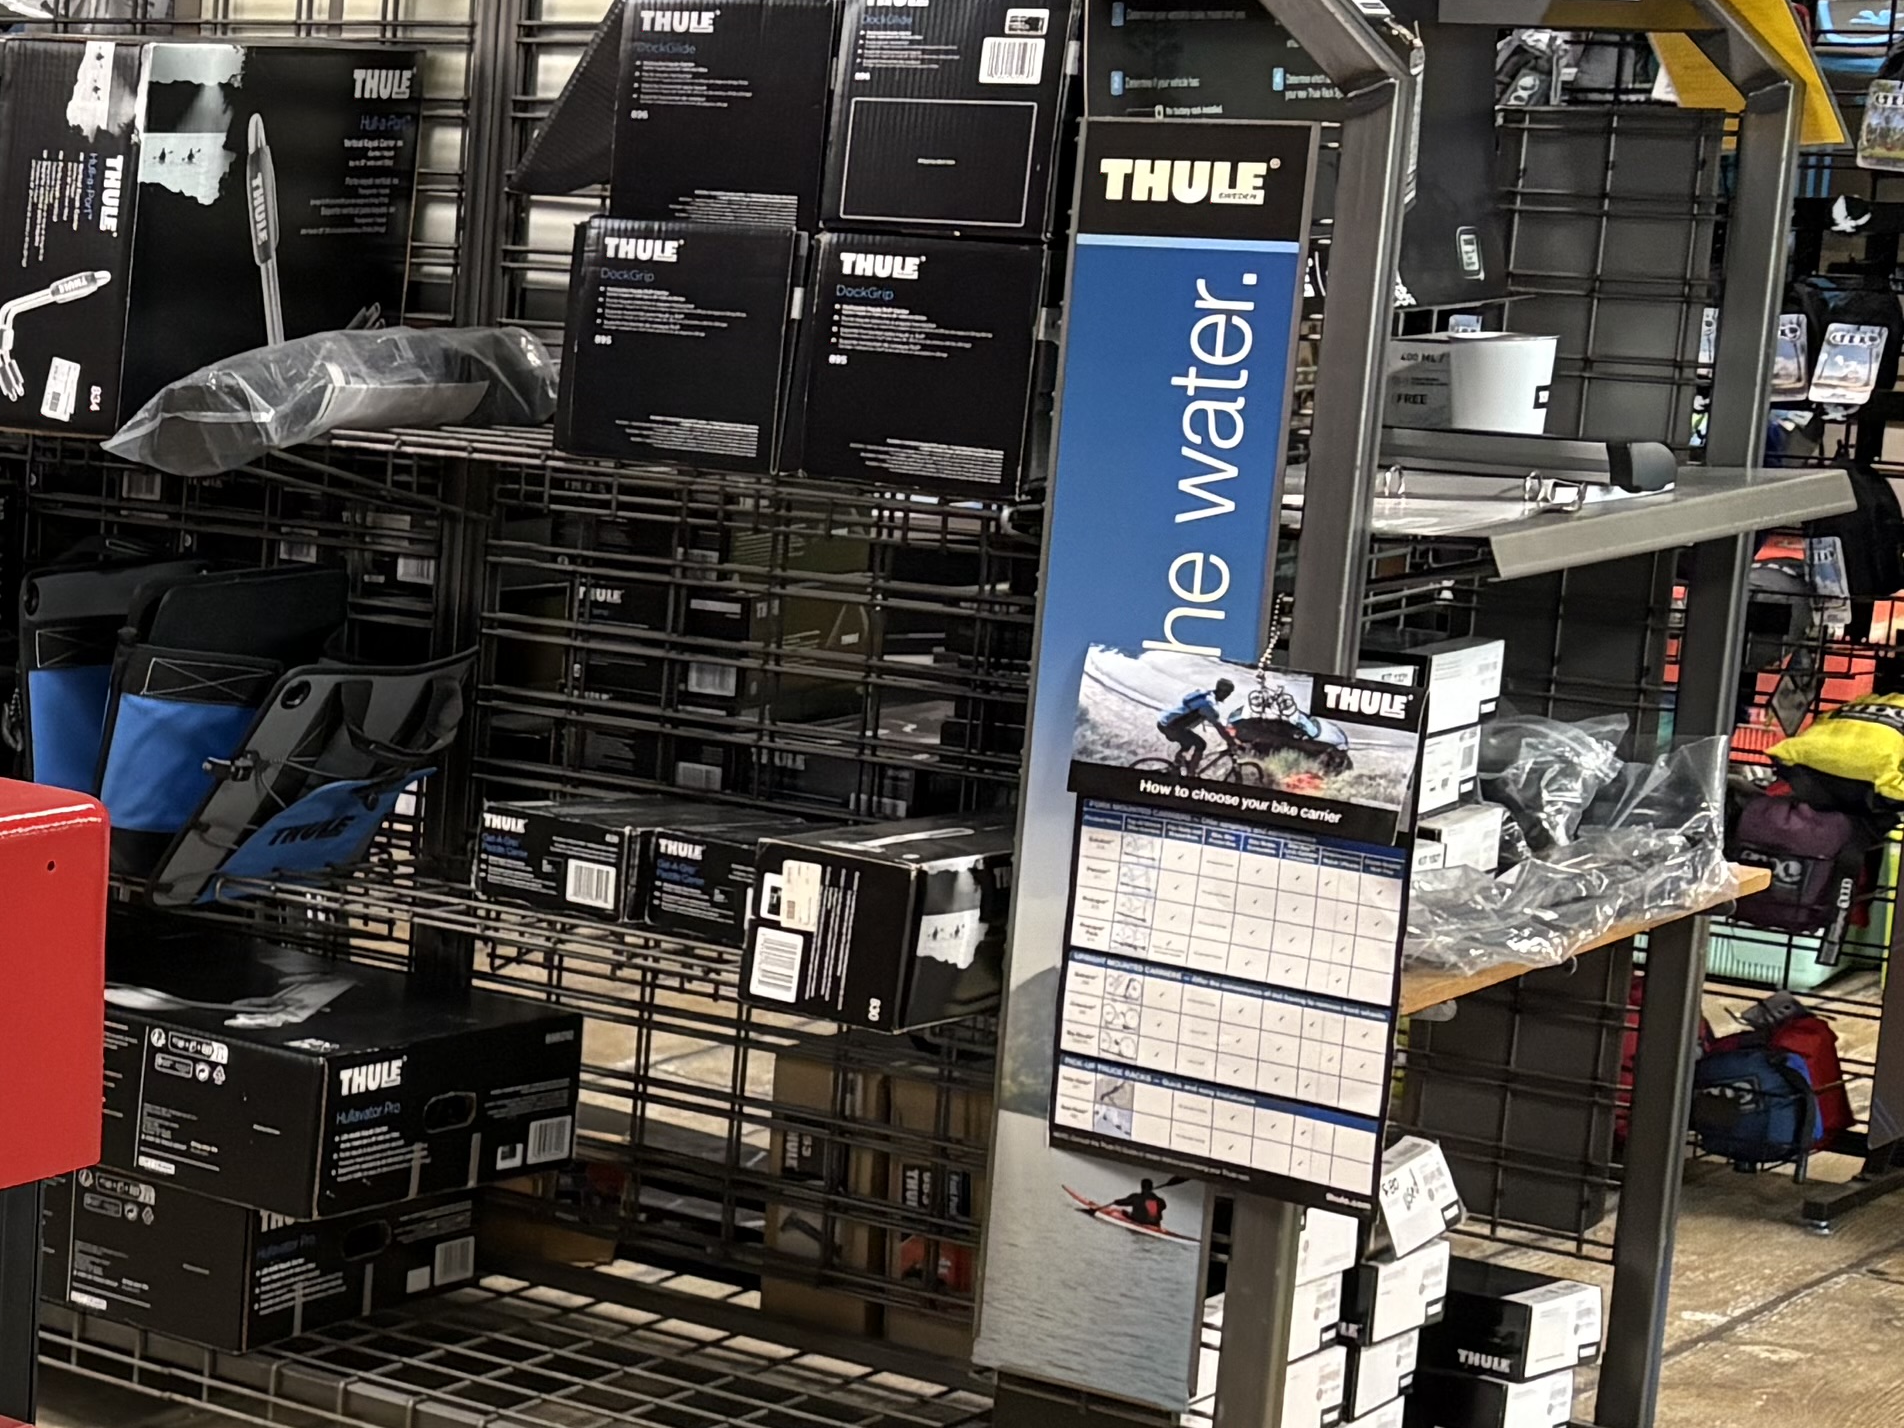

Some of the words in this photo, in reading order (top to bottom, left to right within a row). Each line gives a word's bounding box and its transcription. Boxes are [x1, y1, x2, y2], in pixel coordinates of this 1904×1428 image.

[641, 9, 715, 34] THULE
[99, 155, 124, 231] THULE
[1100, 157, 1268, 206] THULE
[840, 252, 921, 281] THULE
[836, 284, 894, 302] DockGrip
[1171, 273, 1258, 524] water.
[1323, 683, 1409, 719] THULE
[1139, 779, 1168, 796] How
[1171, 785, 1189, 799] to
[1192, 787, 1239, 808] choose
[1242, 796, 1269, 814] your
[1272, 799, 1299, 817] bike
[1301, 804, 1342, 825] carrier
[340, 1057, 403, 1096] THULE
